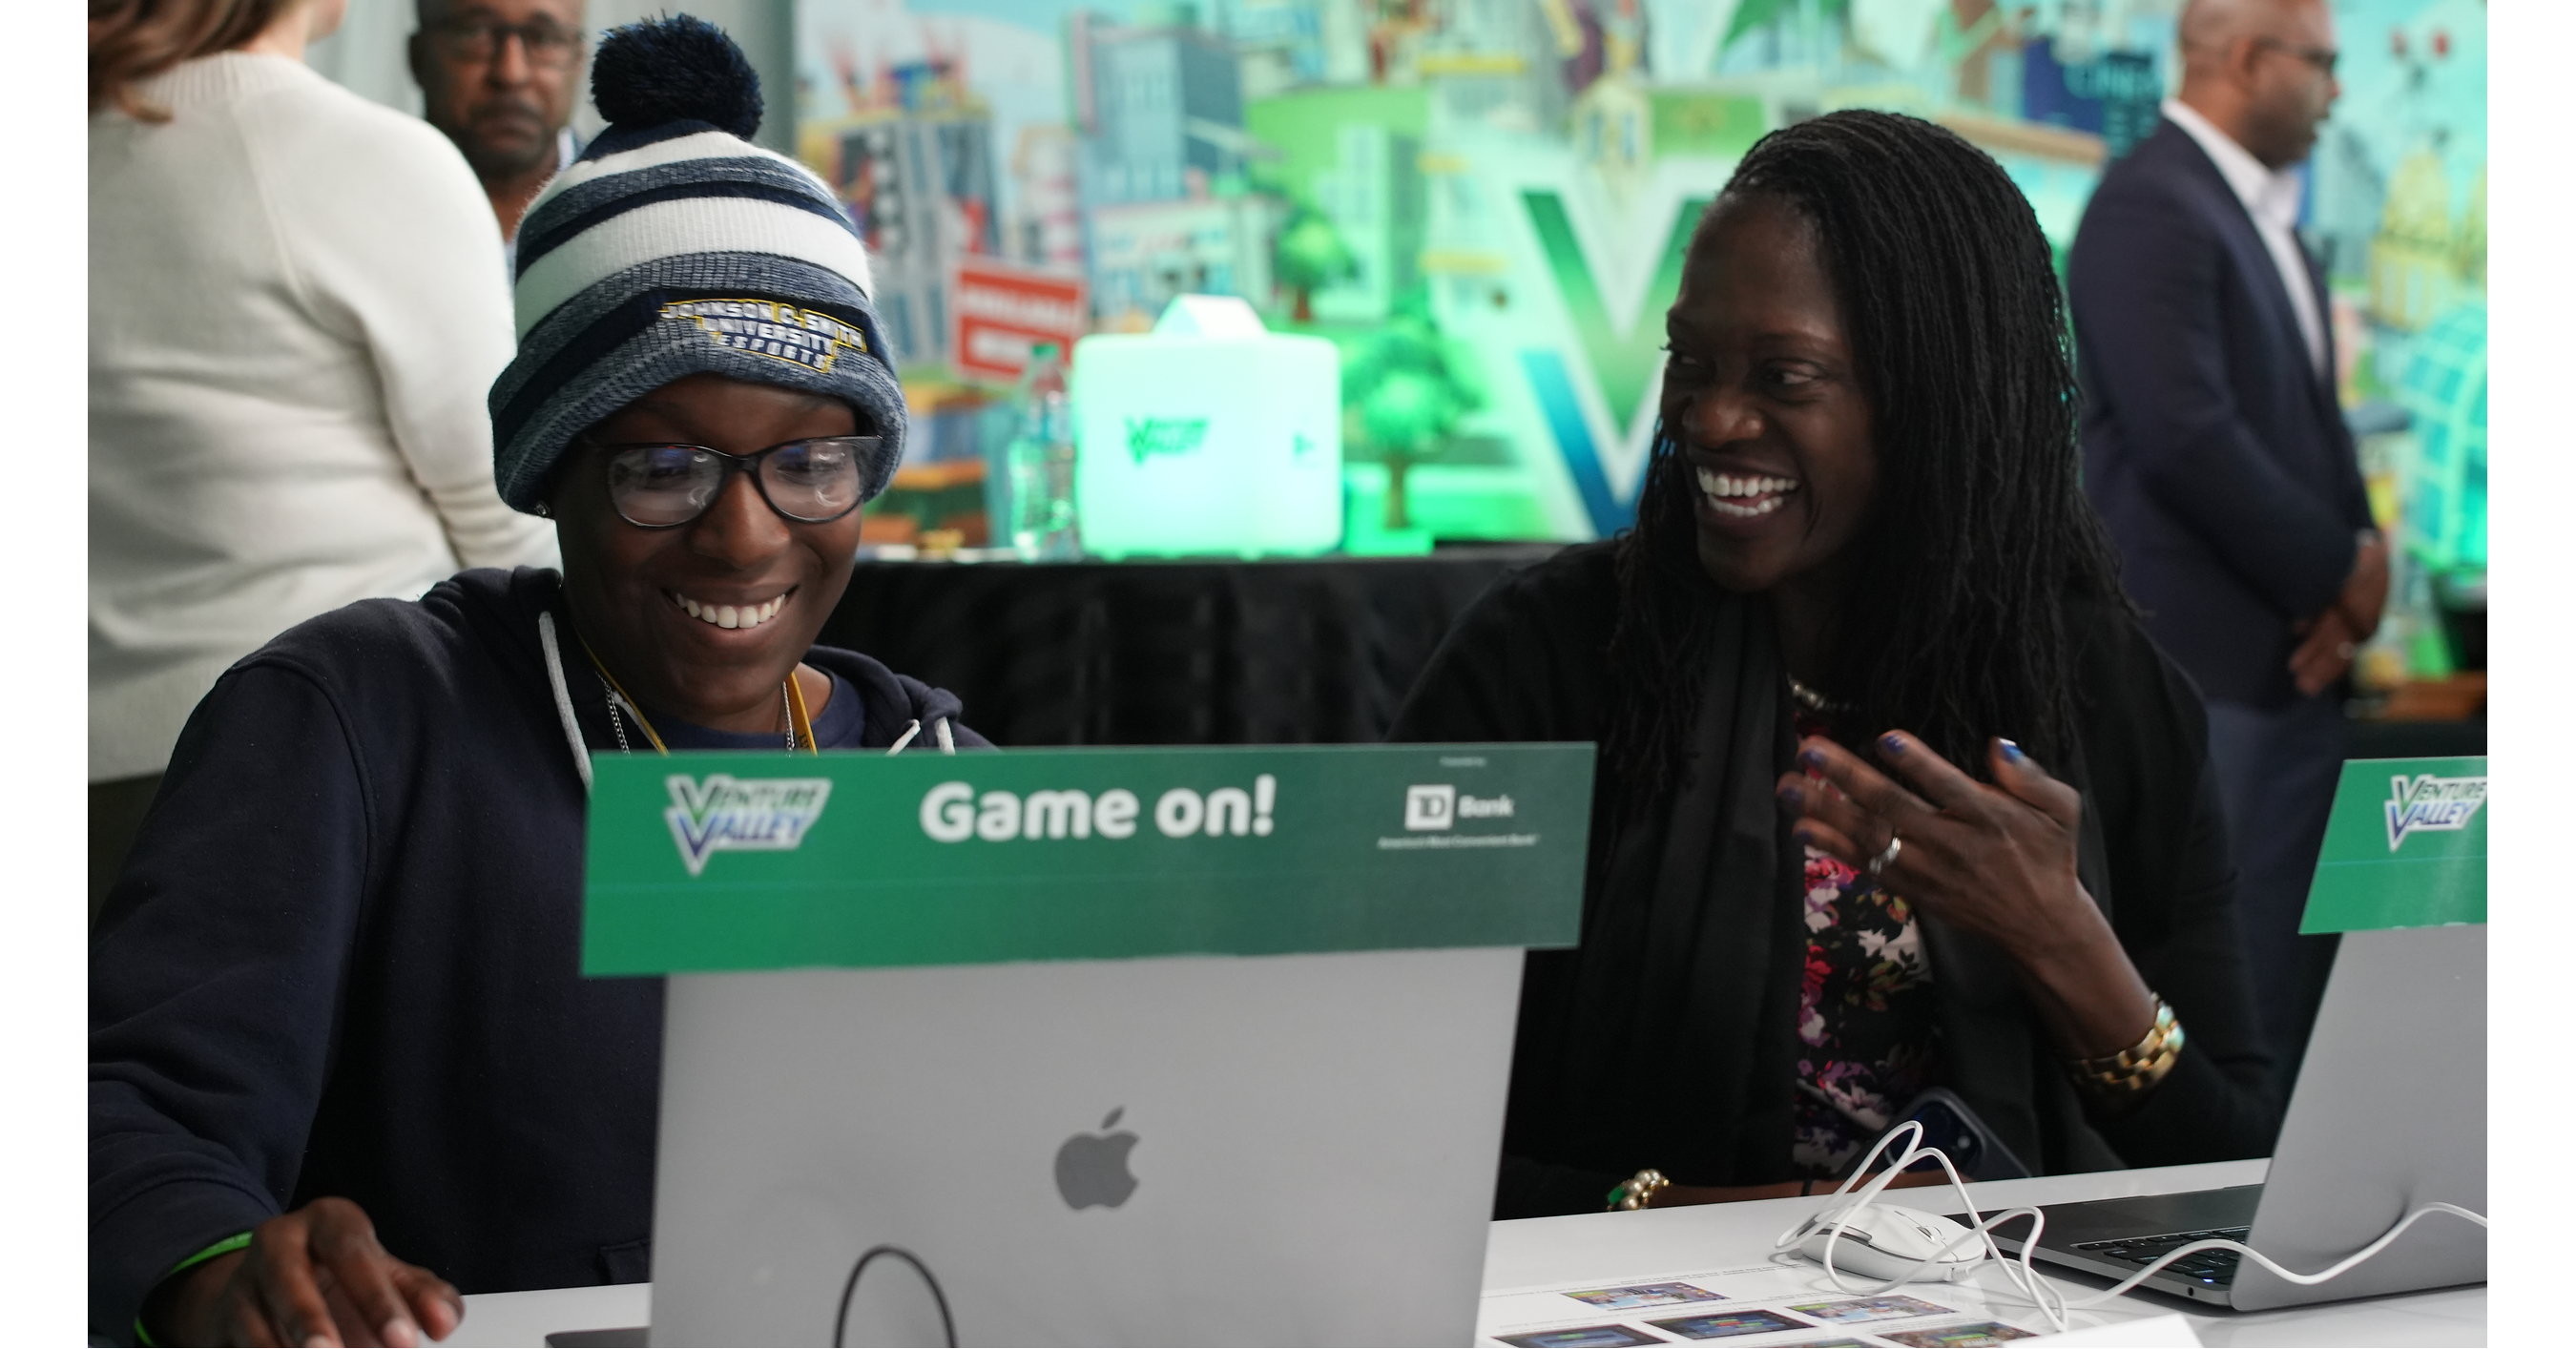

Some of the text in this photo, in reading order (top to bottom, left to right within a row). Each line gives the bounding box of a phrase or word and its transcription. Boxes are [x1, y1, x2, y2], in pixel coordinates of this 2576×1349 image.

[660, 301, 775, 322] JOHNSON
[804, 312, 865, 351] SMITH
[701, 316, 836, 356] UNIVERSITY
[718, 334, 827, 370] ESPORTS
[918, 773, 1278, 844] Game on!
[1458, 794, 1515, 819] Bank
[2388, 802, 2473, 841] VALLEY
[673, 811, 807, 858] VALLEY
